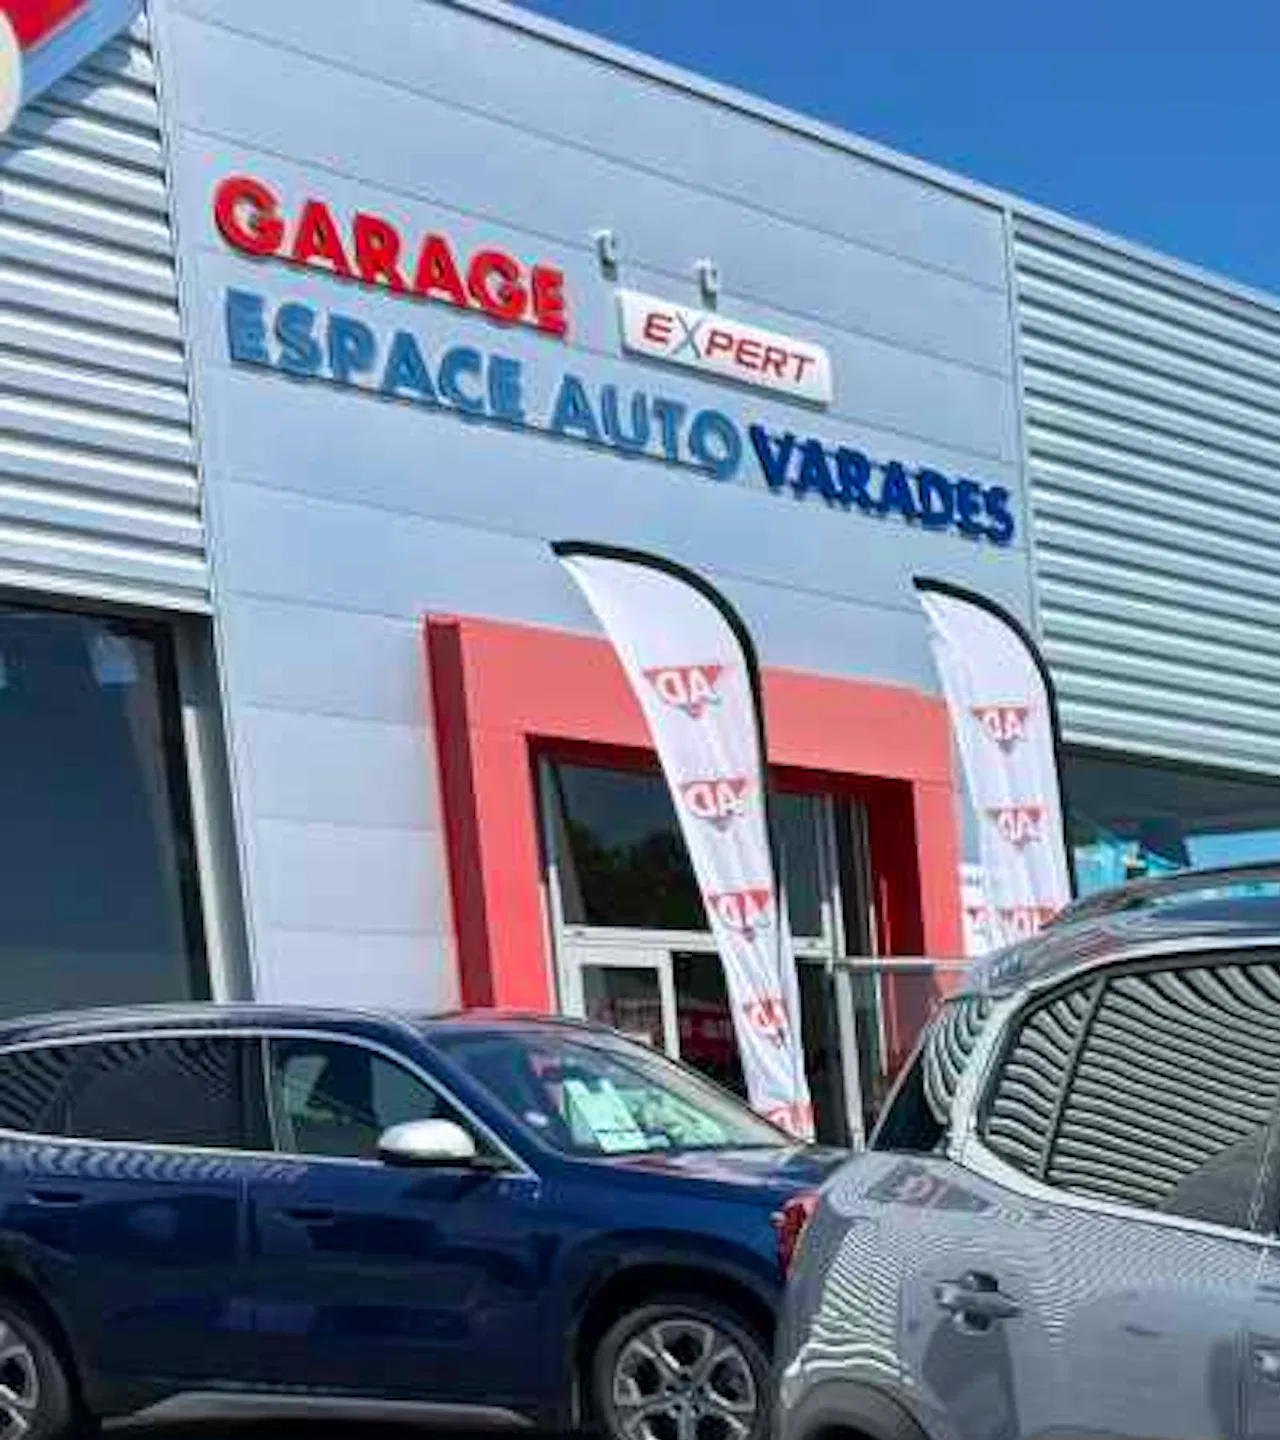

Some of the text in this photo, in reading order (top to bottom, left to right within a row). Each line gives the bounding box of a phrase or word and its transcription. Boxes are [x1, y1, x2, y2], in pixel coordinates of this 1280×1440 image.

[213, 174, 568, 341] GARAGE
[226, 287, 1015, 548] ESPACE AUTO VARADES
[643, 310, 816, 384] EXPERT
